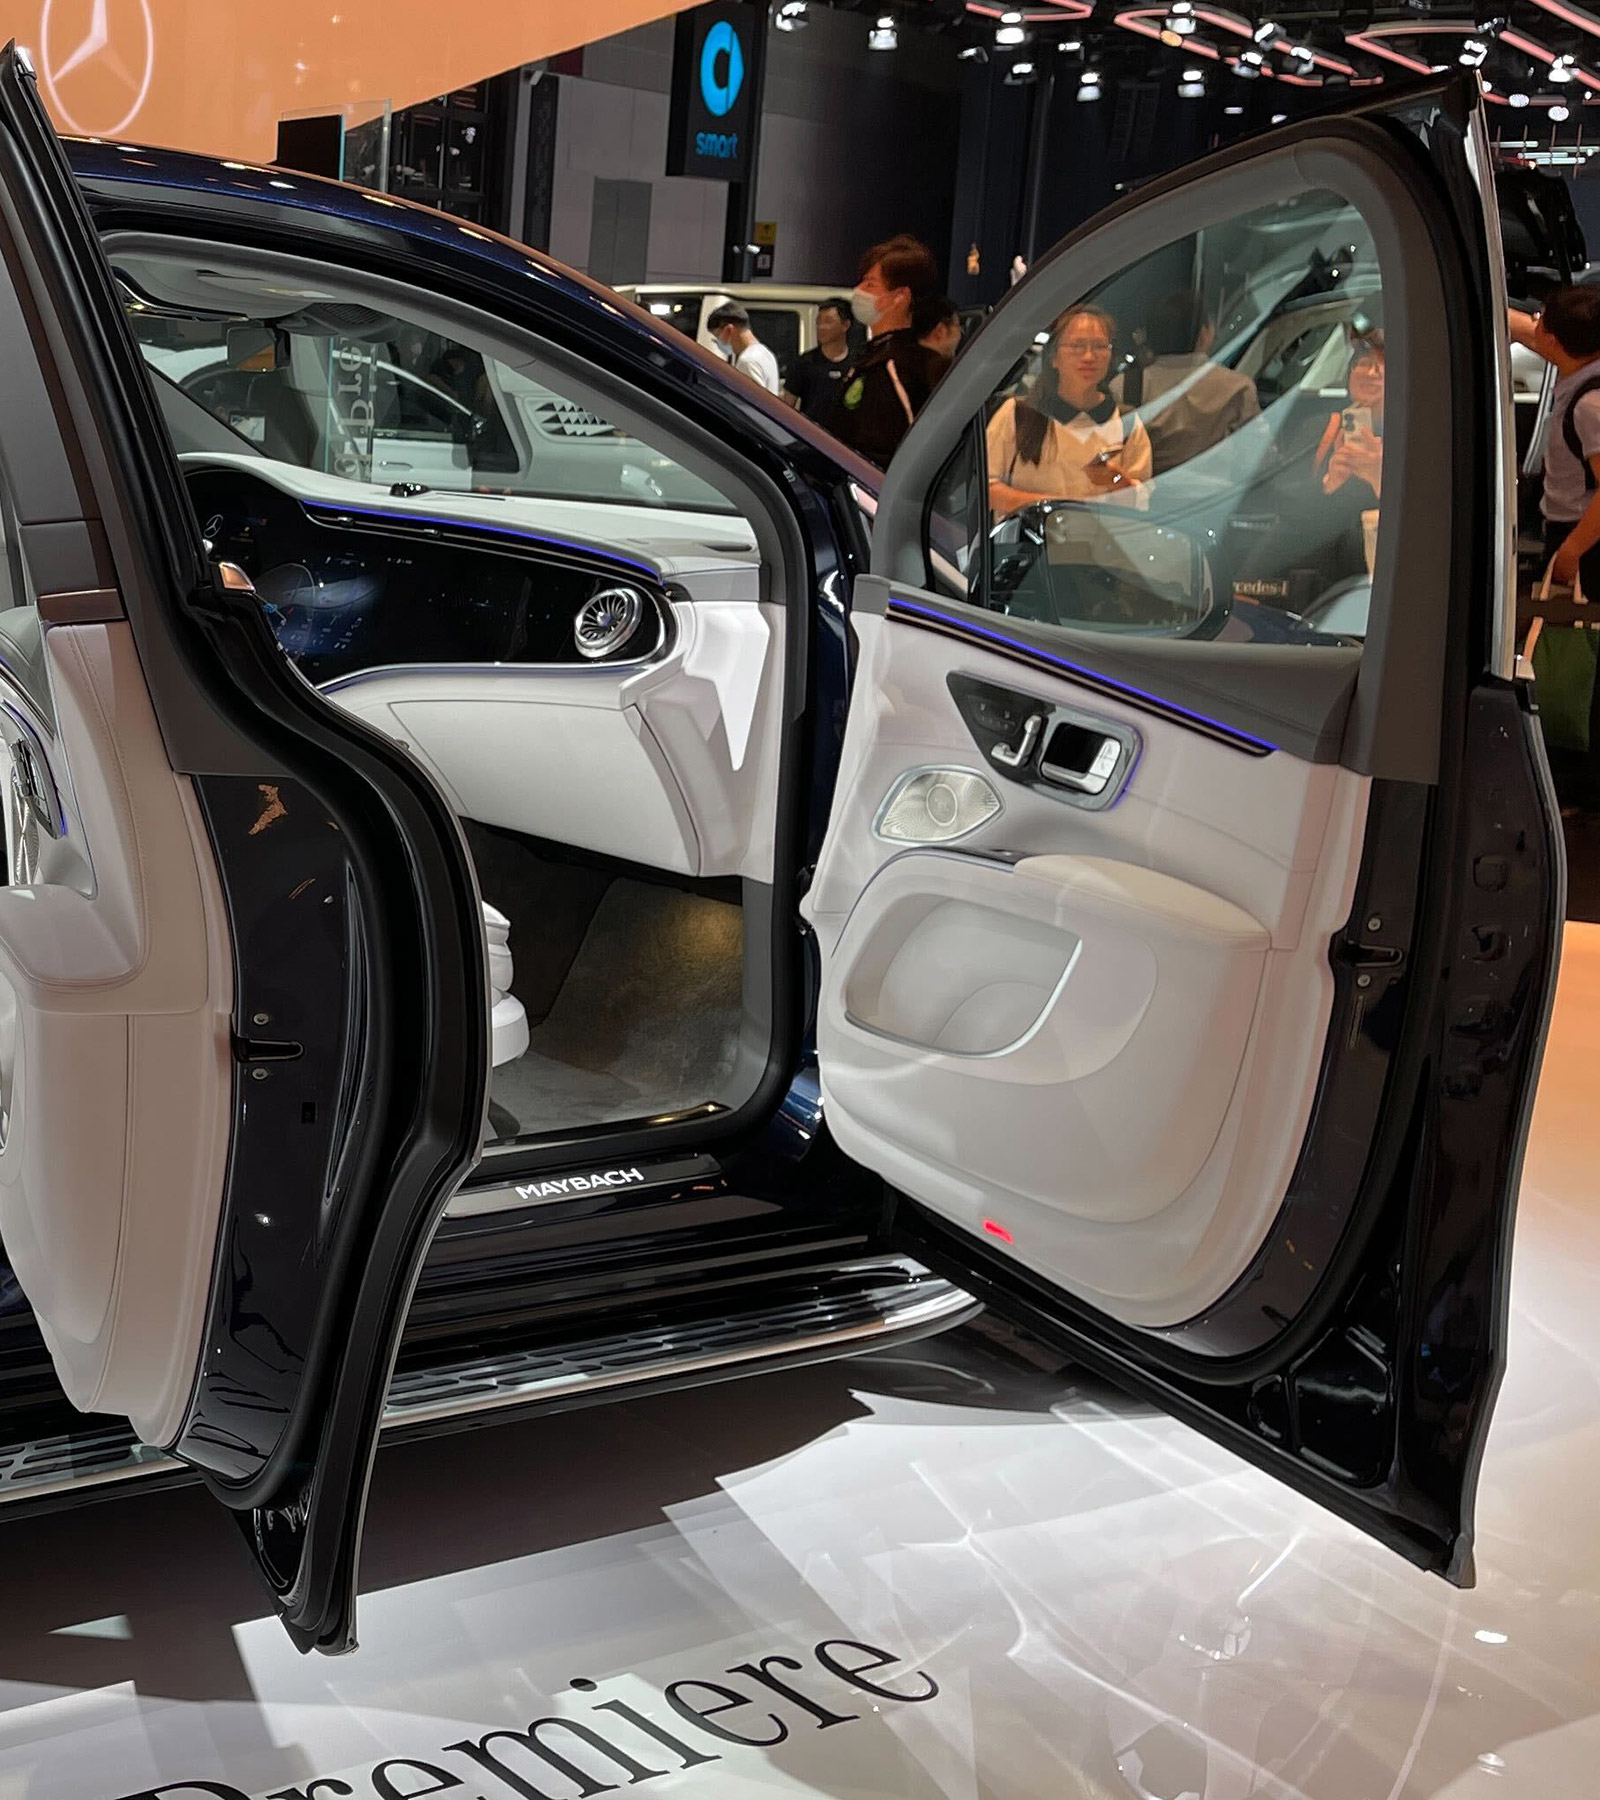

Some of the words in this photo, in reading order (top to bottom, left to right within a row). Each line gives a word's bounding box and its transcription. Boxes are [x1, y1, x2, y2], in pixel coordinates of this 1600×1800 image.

[696, 131, 738, 158] smart
[515, 1167, 644, 1199] MAYBACH
[112, 1639, 939, 1800] emiere
